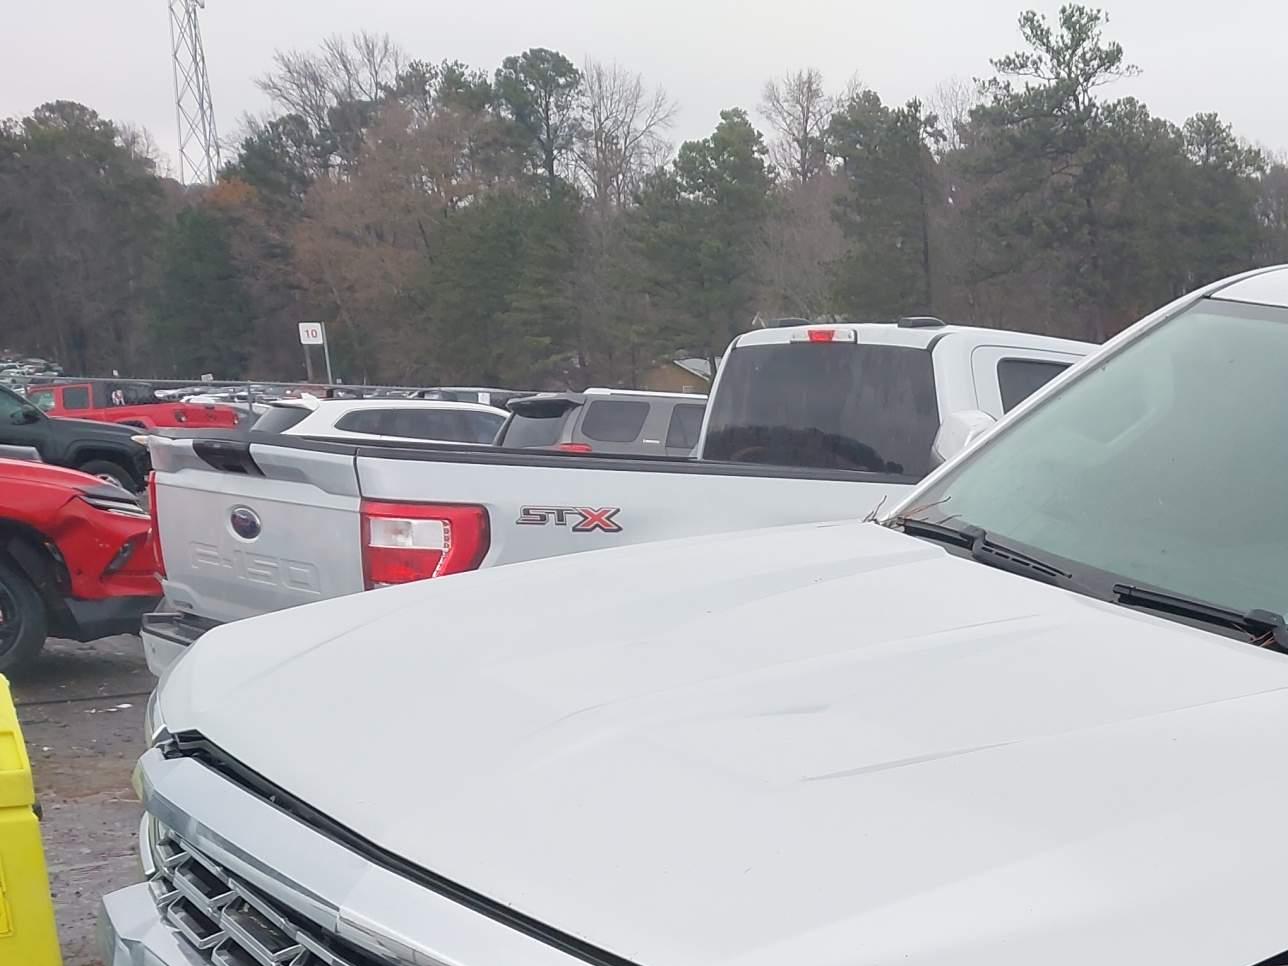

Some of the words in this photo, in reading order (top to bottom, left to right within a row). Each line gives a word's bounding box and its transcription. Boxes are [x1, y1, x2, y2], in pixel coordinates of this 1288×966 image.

[304, 329, 318, 338] 10
[515, 505, 623, 533] STX
[190, 540, 322, 595] F-150
